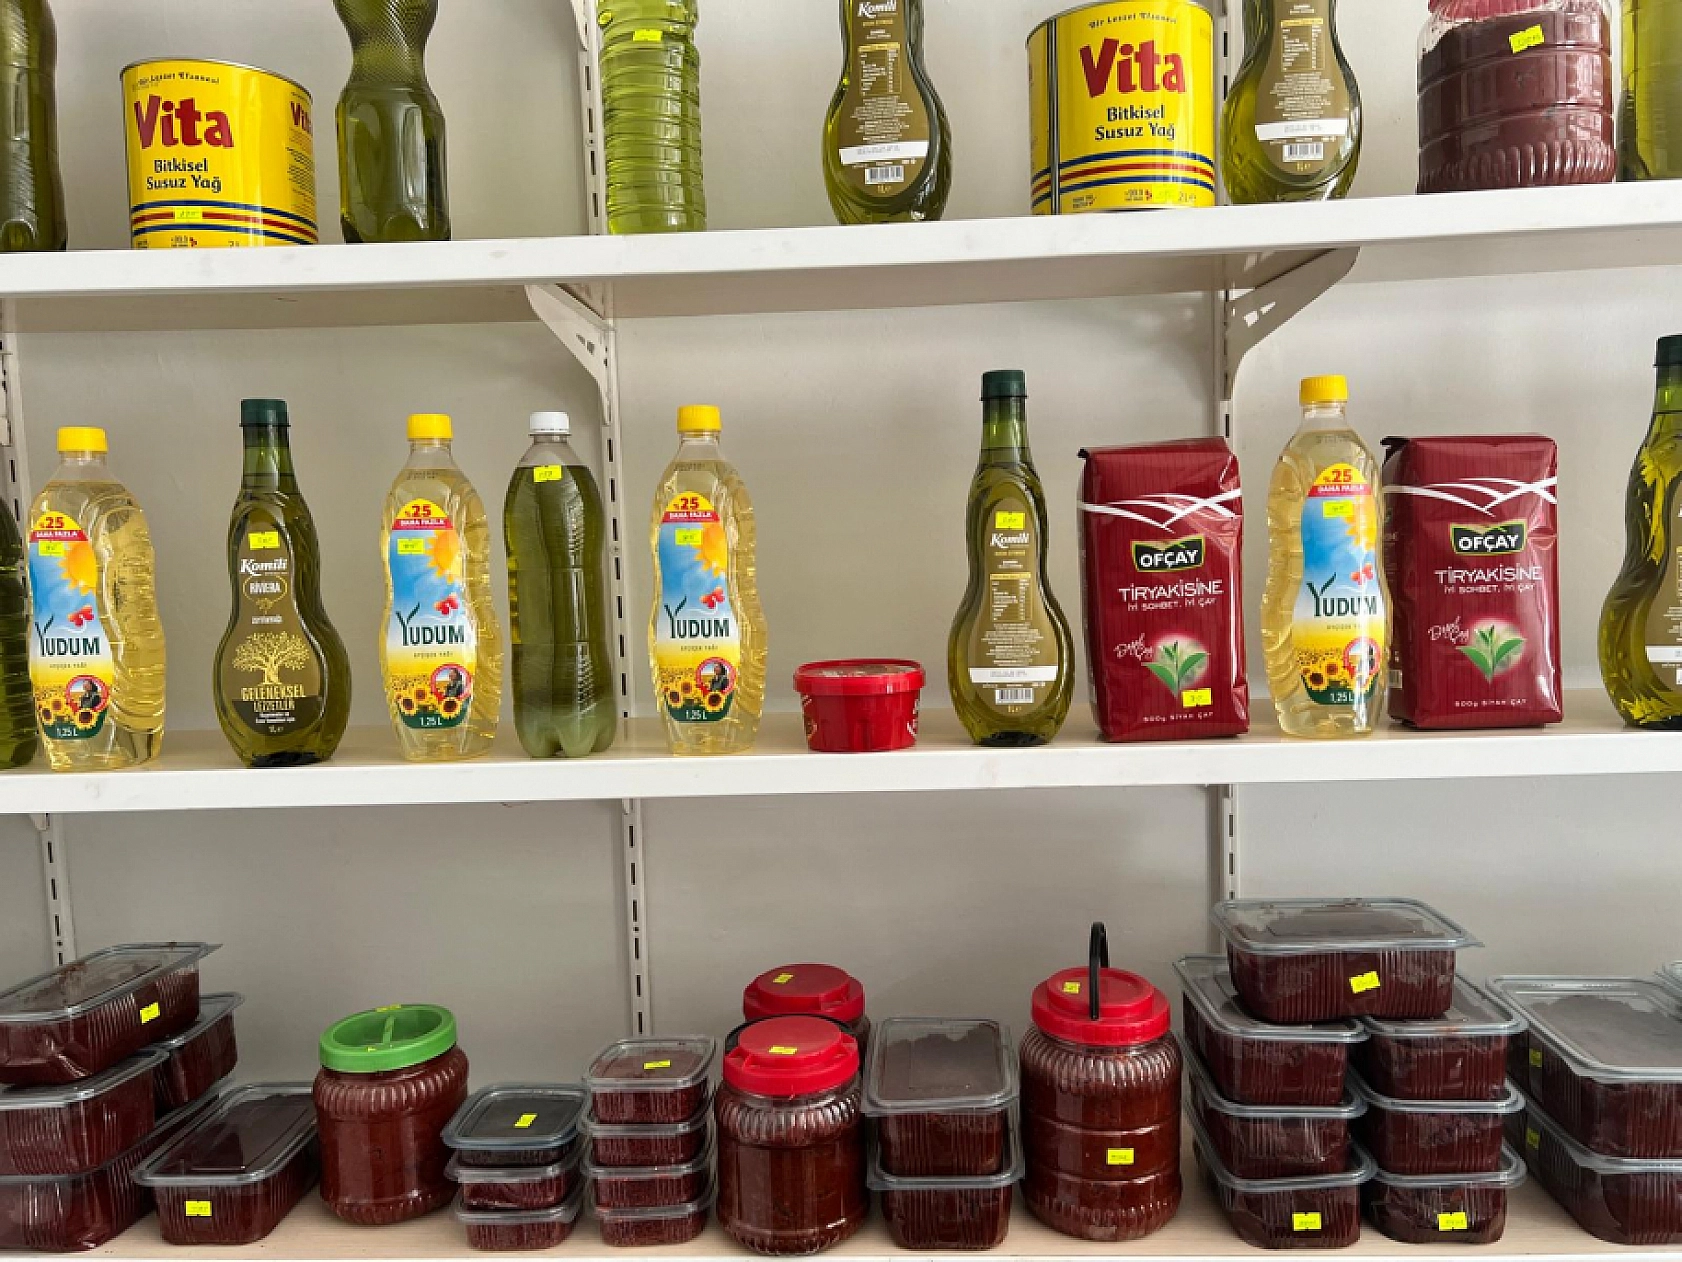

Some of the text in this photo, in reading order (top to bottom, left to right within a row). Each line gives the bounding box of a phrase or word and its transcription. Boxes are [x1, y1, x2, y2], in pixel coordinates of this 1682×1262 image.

[1079, 38, 1186, 98] Vita
[134, 94, 234, 149] Vita
[291, 101, 312, 133] Vit
[1107, 104, 1165, 122] Bitkisel
[1095, 122, 1175, 141] Susuz Yağ
[154, 157, 208, 173] Bitkisel
[147, 174, 221, 193] Susuz Yağ
[1458, 534, 1519, 552] OFÇAY
[240, 558, 287, 576] Komili
[1140, 549, 1199, 569] OFÇAY
[1434, 562, 1543, 584] TİRYAKİSİNE
[1118, 578, 1224, 602] TİRYAKİSİNE
[396, 601, 464, 646] YUDUM
[664, 596, 729, 638] YUDUM
[35, 614, 101, 656] YUDUM
